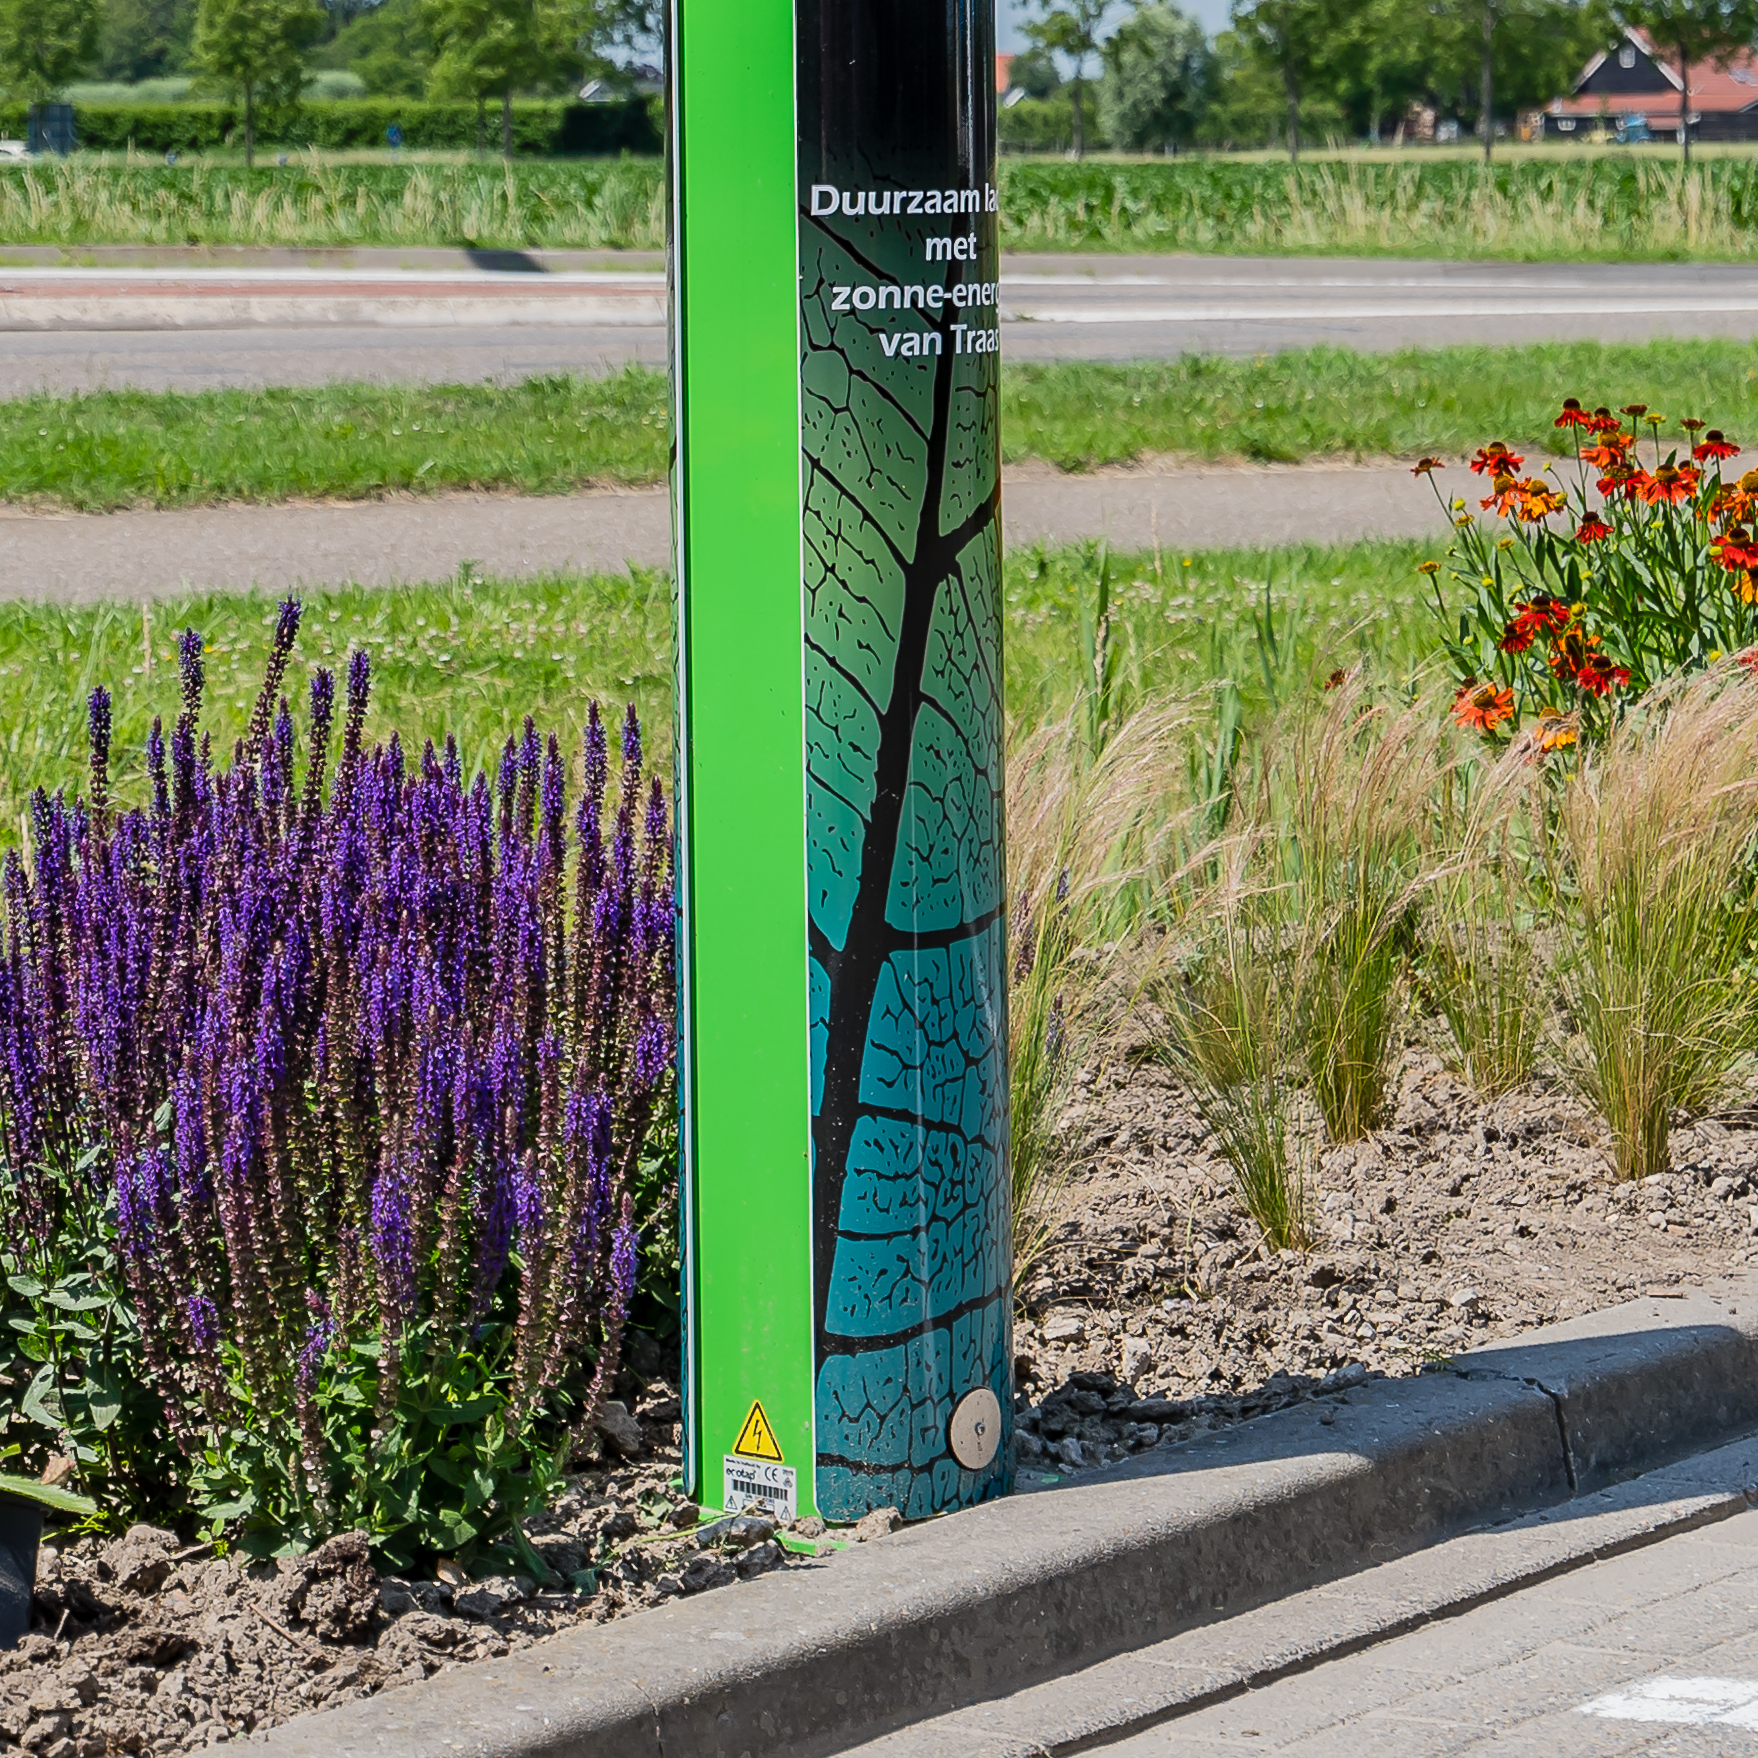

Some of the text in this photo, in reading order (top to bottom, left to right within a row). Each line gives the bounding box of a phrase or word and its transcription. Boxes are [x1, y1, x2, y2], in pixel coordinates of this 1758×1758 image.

[810, 184, 980, 216] Duurzaam
[925, 232, 977, 261] met
[878, 330, 942, 357] van
